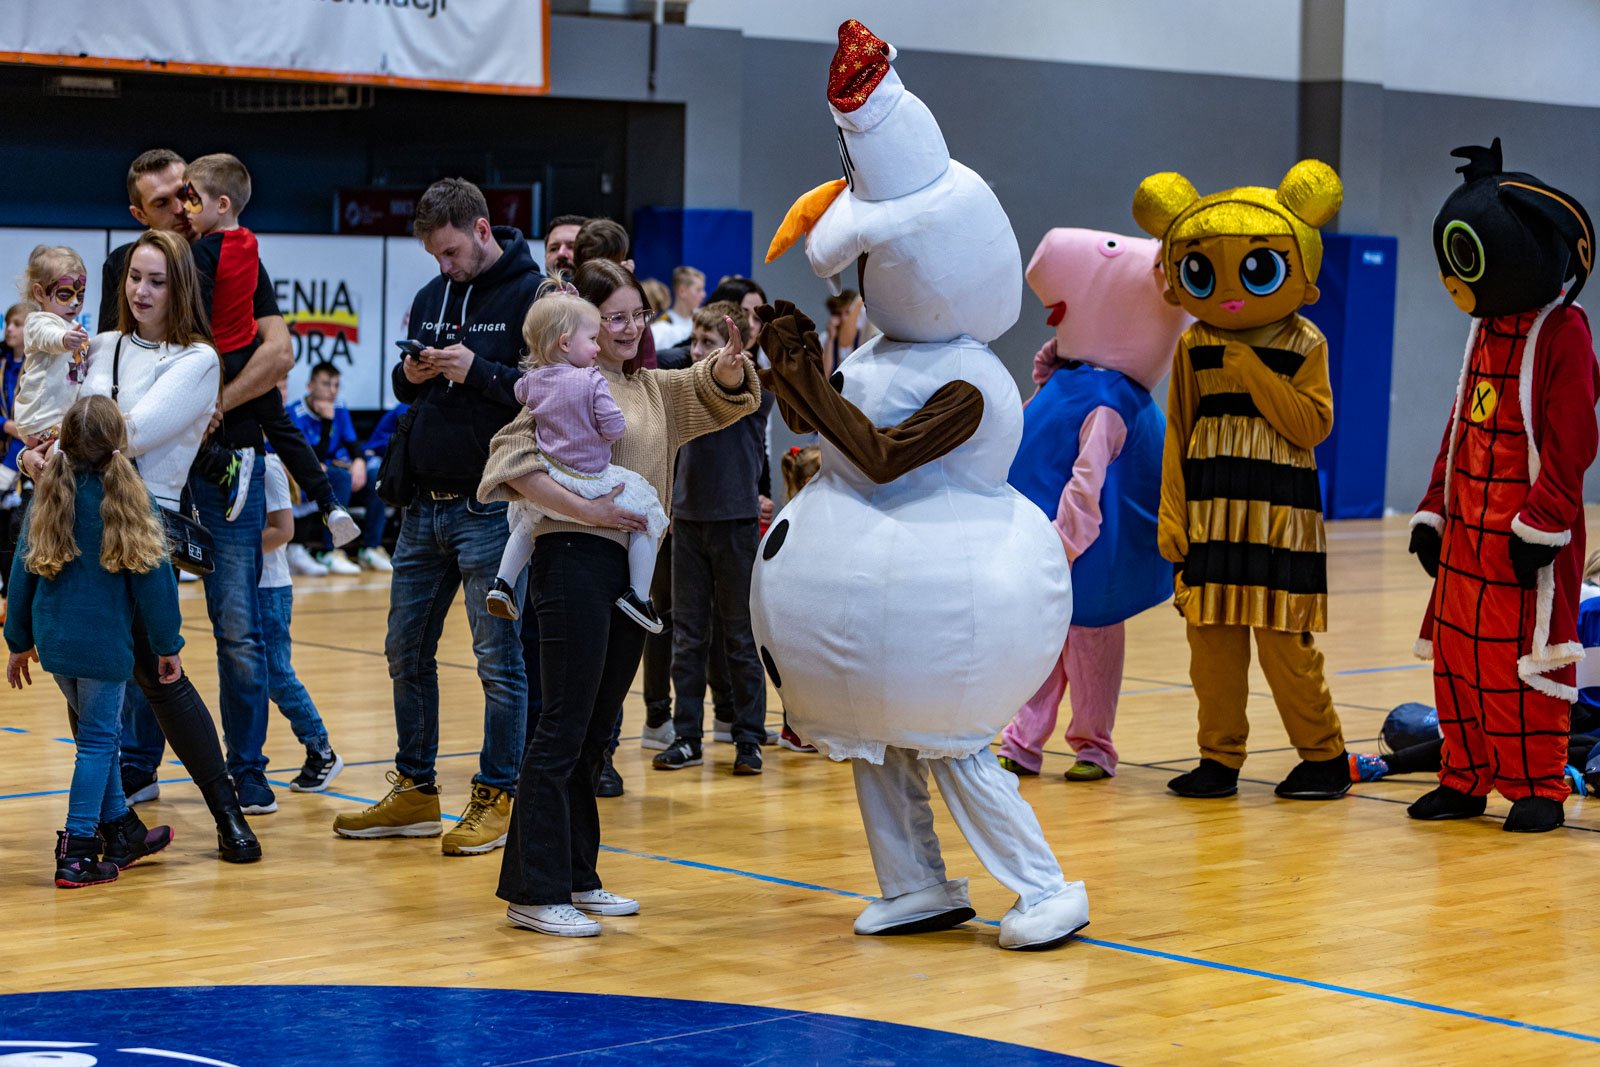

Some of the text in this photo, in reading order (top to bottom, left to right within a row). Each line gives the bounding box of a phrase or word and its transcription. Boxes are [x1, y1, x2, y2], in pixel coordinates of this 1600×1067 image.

[274, 280, 354, 315] ENIA
[288, 321, 353, 365] ÓRA
[468, 322, 506, 332] ILFIGER
